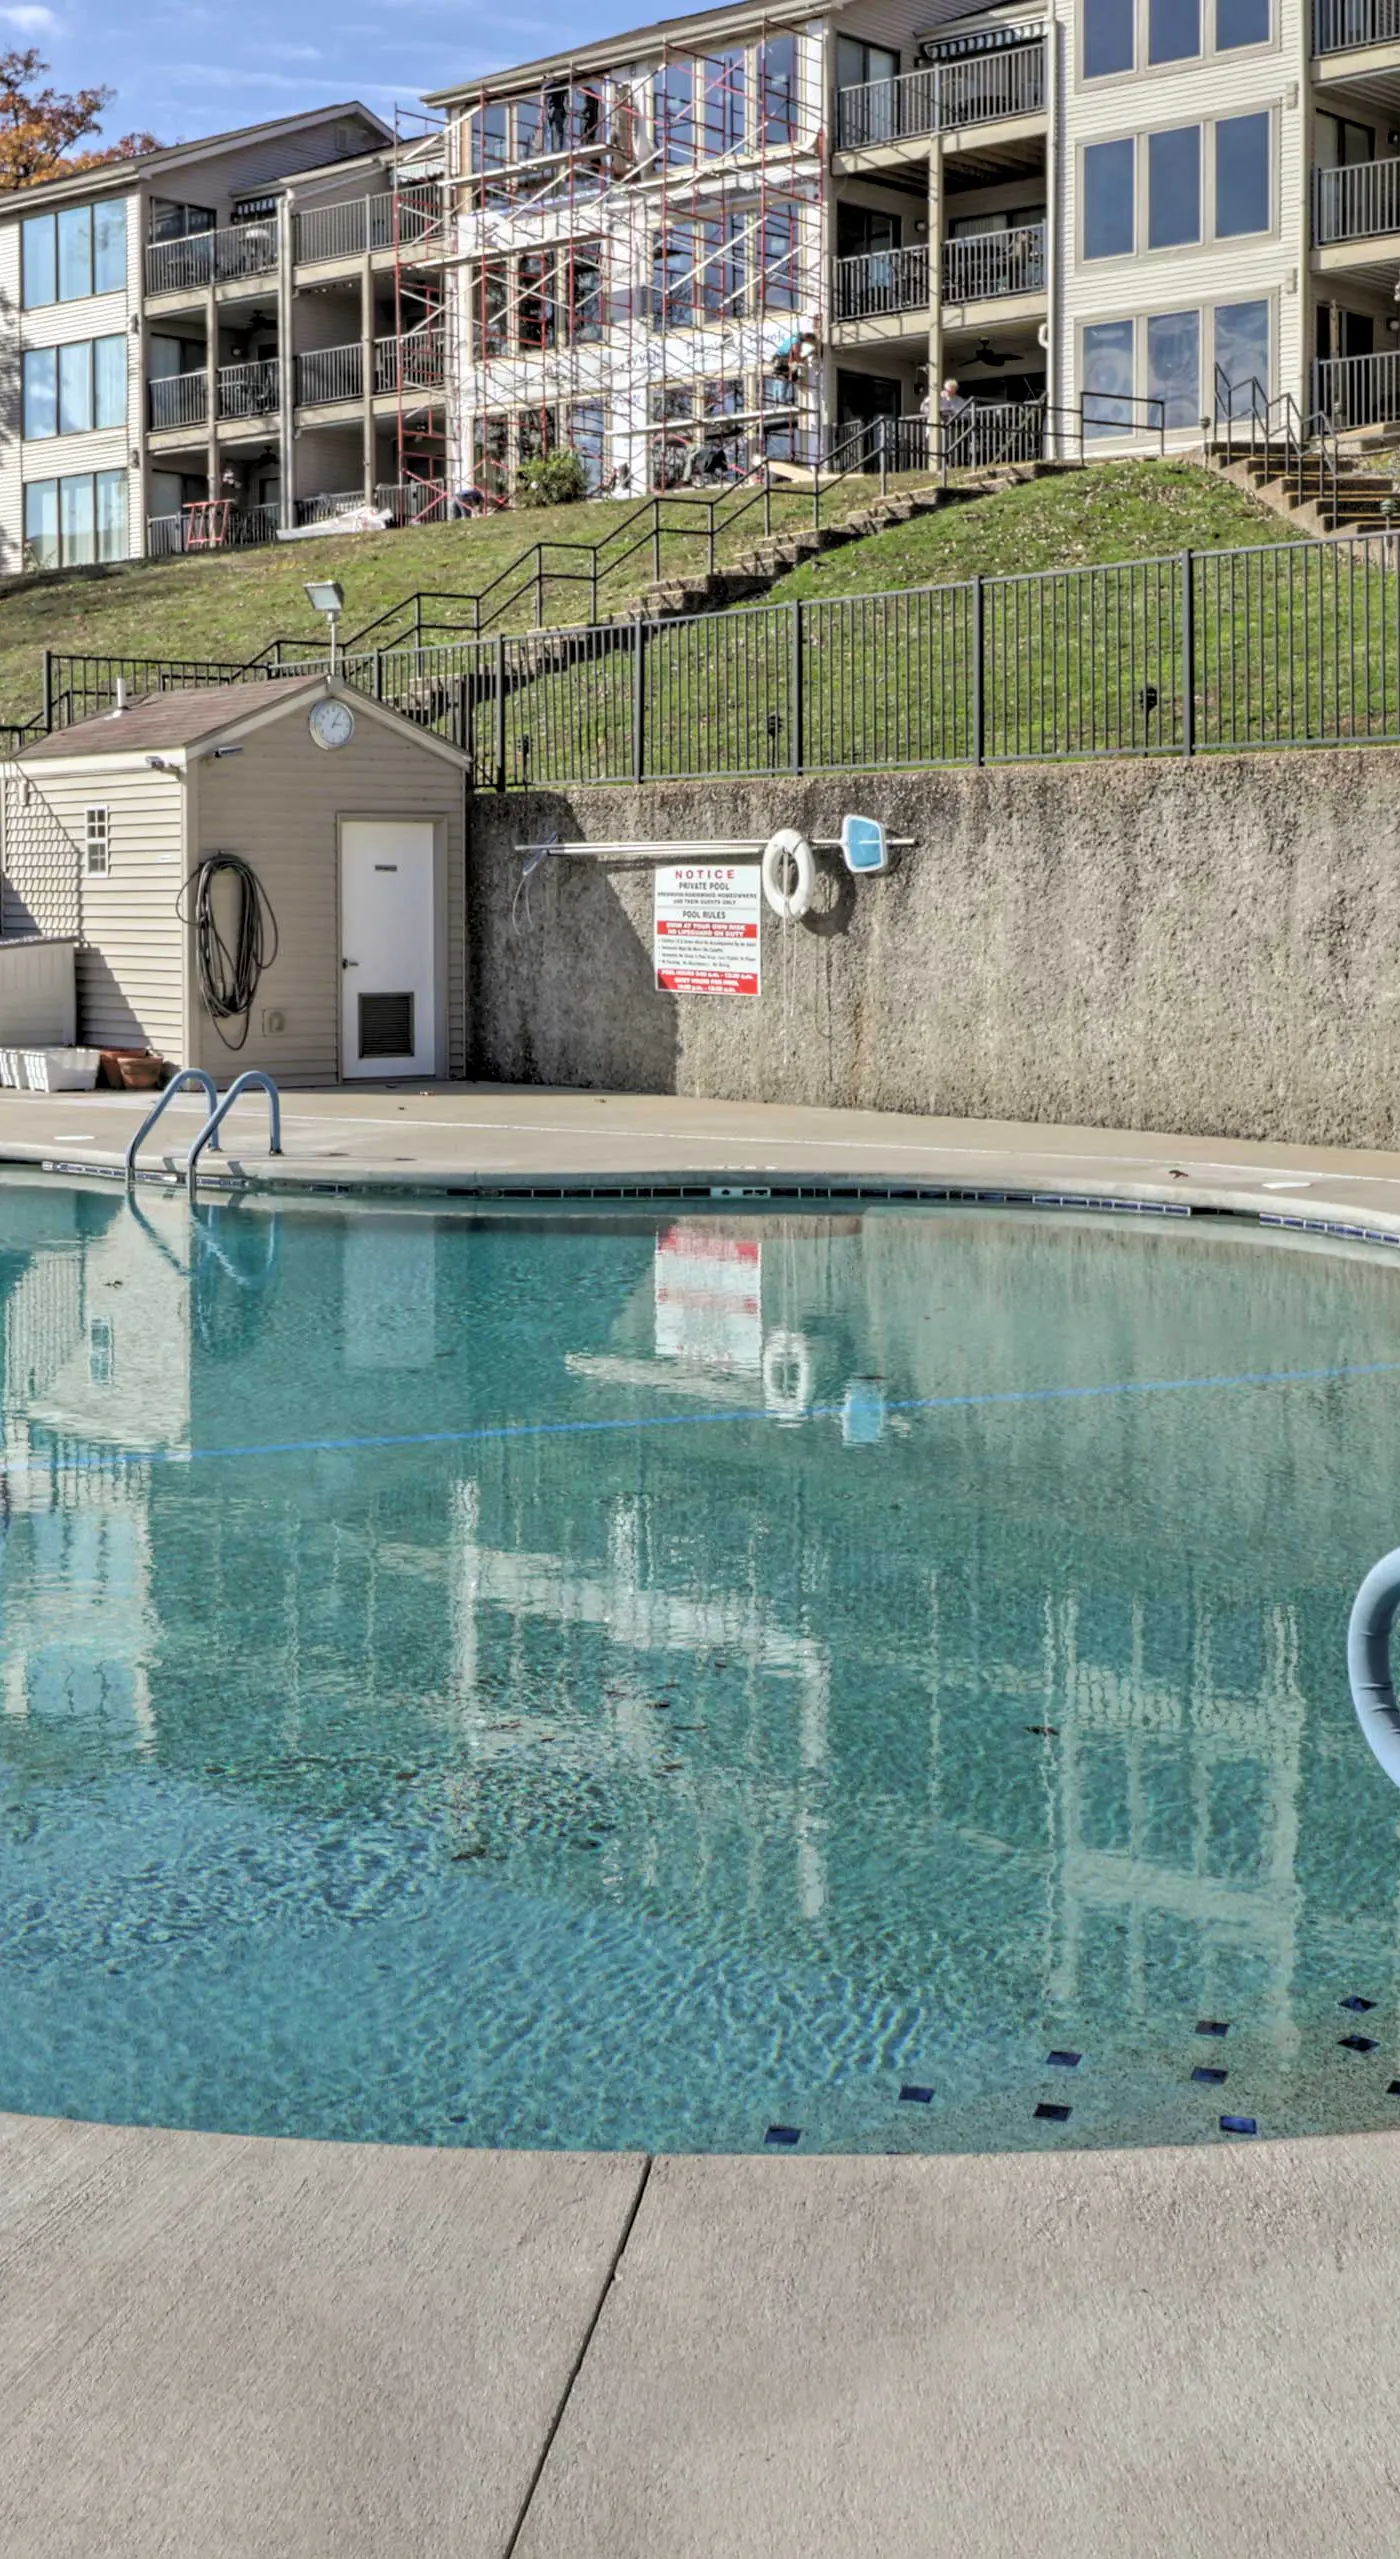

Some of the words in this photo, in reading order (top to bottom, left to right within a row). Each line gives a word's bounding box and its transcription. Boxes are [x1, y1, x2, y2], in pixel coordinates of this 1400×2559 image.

[675, 869, 735, 879] NOTICE
[678, 882, 707, 890] PRIVATE
[709, 882, 730, 891] POOL
[682, 910, 700, 919] POOL
[703, 911, 726, 920] RULES
[725, 930, 744, 938] DUTY
